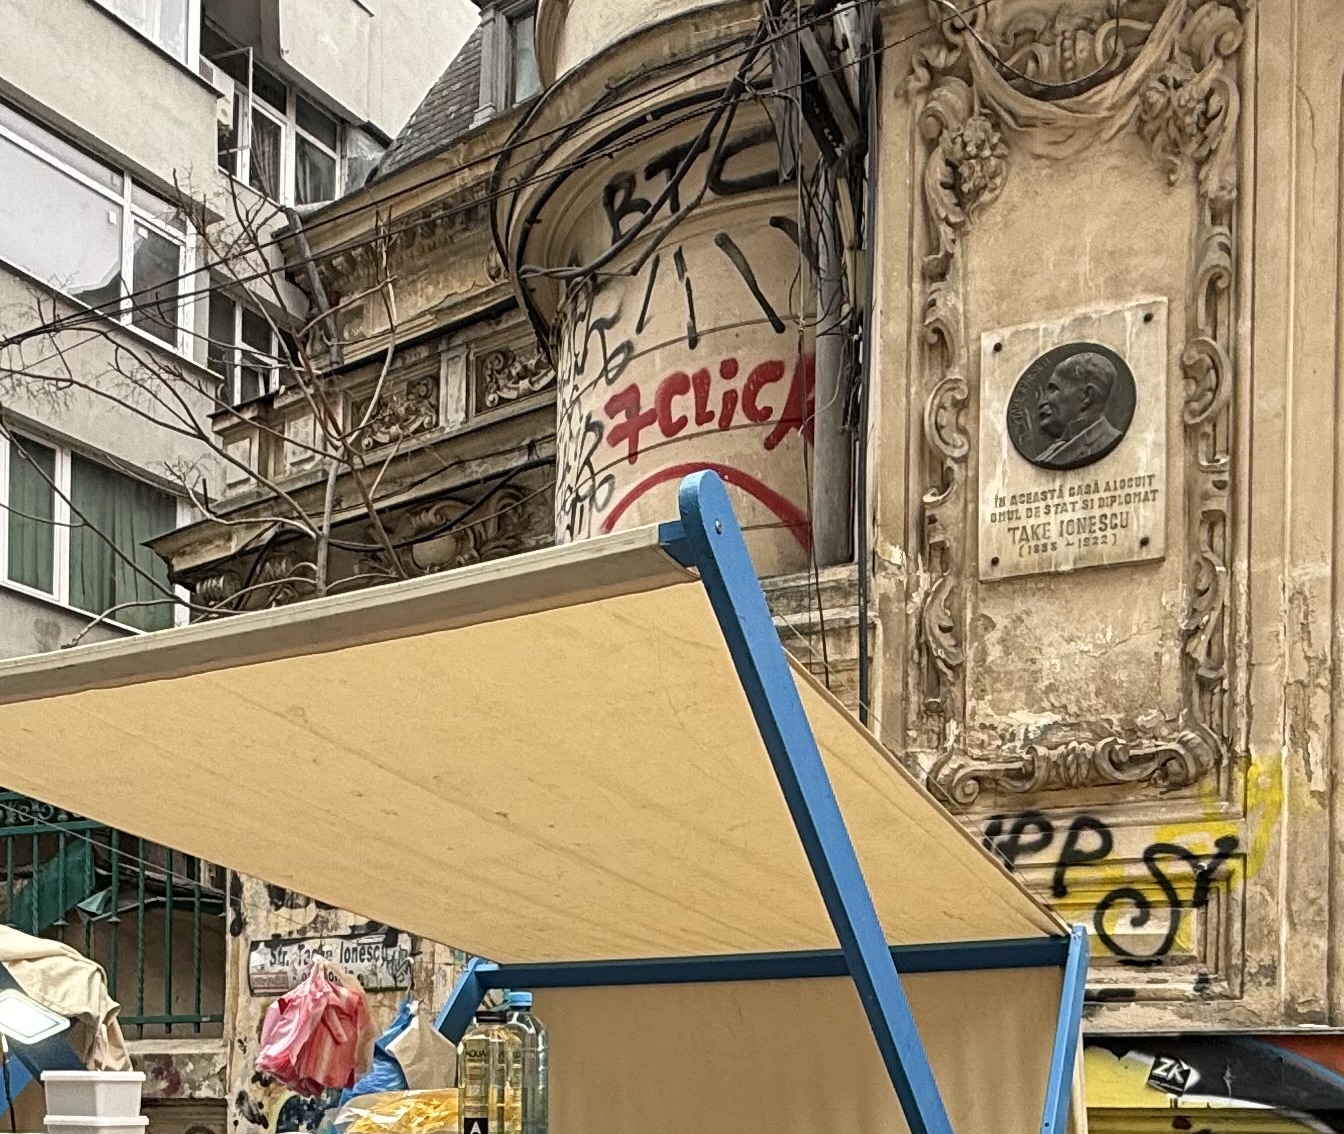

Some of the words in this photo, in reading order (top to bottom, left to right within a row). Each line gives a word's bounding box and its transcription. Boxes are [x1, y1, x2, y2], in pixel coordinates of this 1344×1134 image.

[990, 509, 1022, 523] OMUL
[1025, 506, 1041, 519] DE
[1043, 501, 1079, 516] STAT
[1097, 489, 1159, 509] DIPLOMAT
[1009, 485, 1064, 506] ACEASTĂ
[1068, 479, 1101, 497] CASĂ
[1008, 522, 1051, 545] TAKE
[1059, 511, 1130, 538] IONESCU
[1152, 1057, 1184, 1084] ZK
